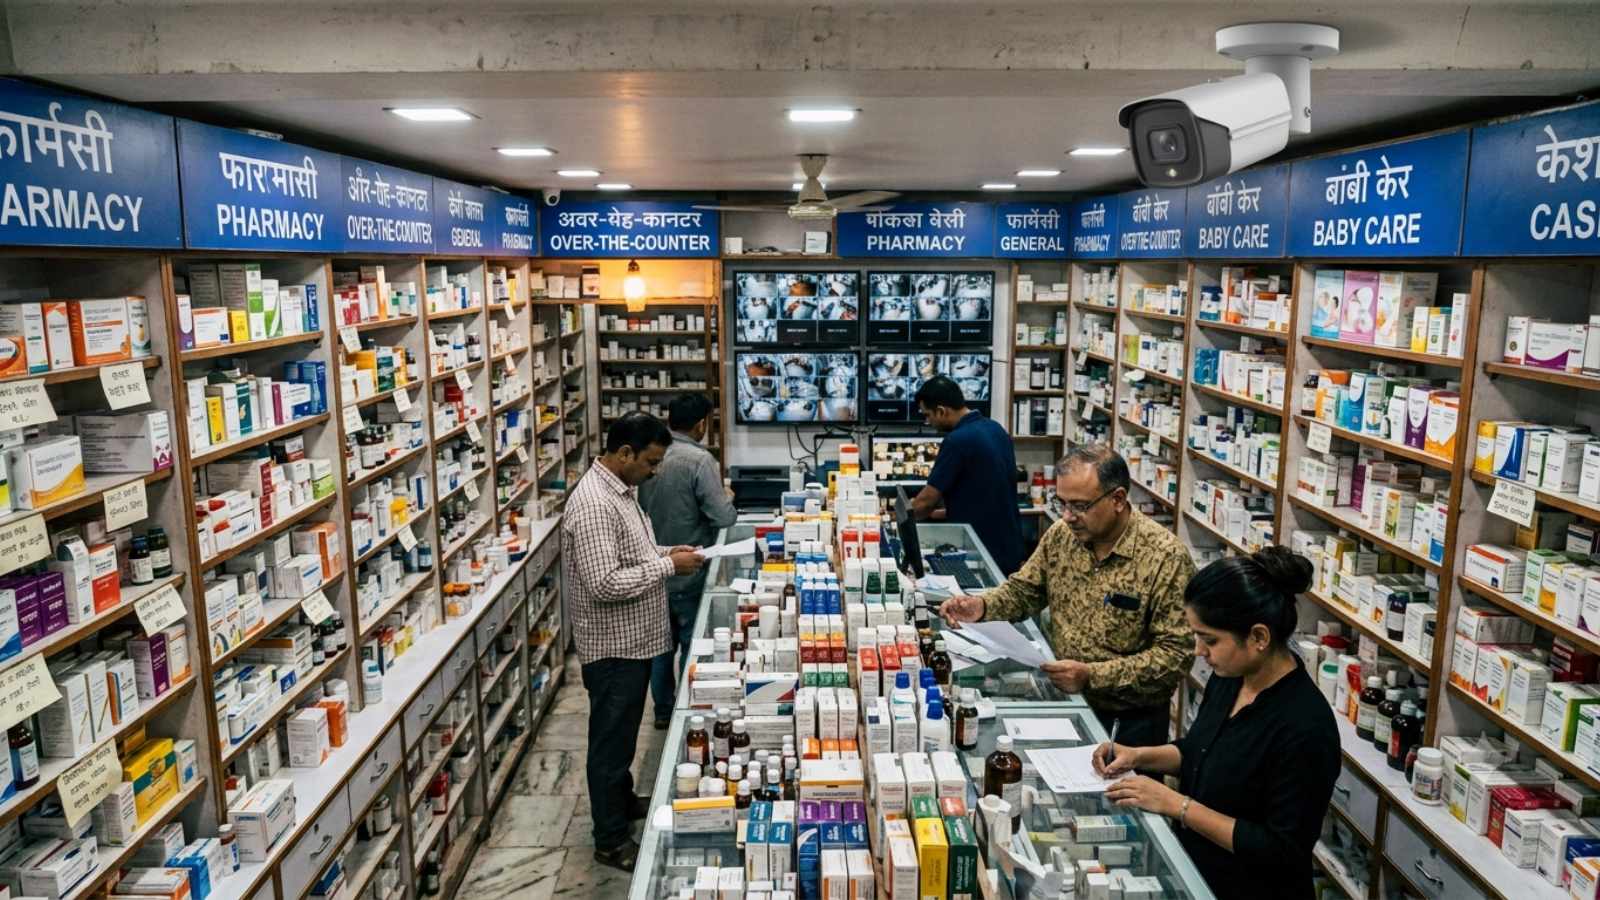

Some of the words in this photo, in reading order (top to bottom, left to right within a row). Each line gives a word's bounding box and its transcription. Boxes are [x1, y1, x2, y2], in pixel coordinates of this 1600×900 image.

[1376, 155, 1413, 200] केर
[217, 204, 324, 240] PHARMACY
[1313, 217, 1362, 246] BABY
[1365, 213, 1422, 245] CARE
[1530, 200, 1600, 241] CAS
[550, 235, 711, 250] OVER-THE-COUNTER
[867, 235, 965, 251] PHARMACY
[1001, 236, 1064, 251] GENERAL
[1199, 226, 1231, 249] BABY
[1233, 224, 1270, 248] CARE
